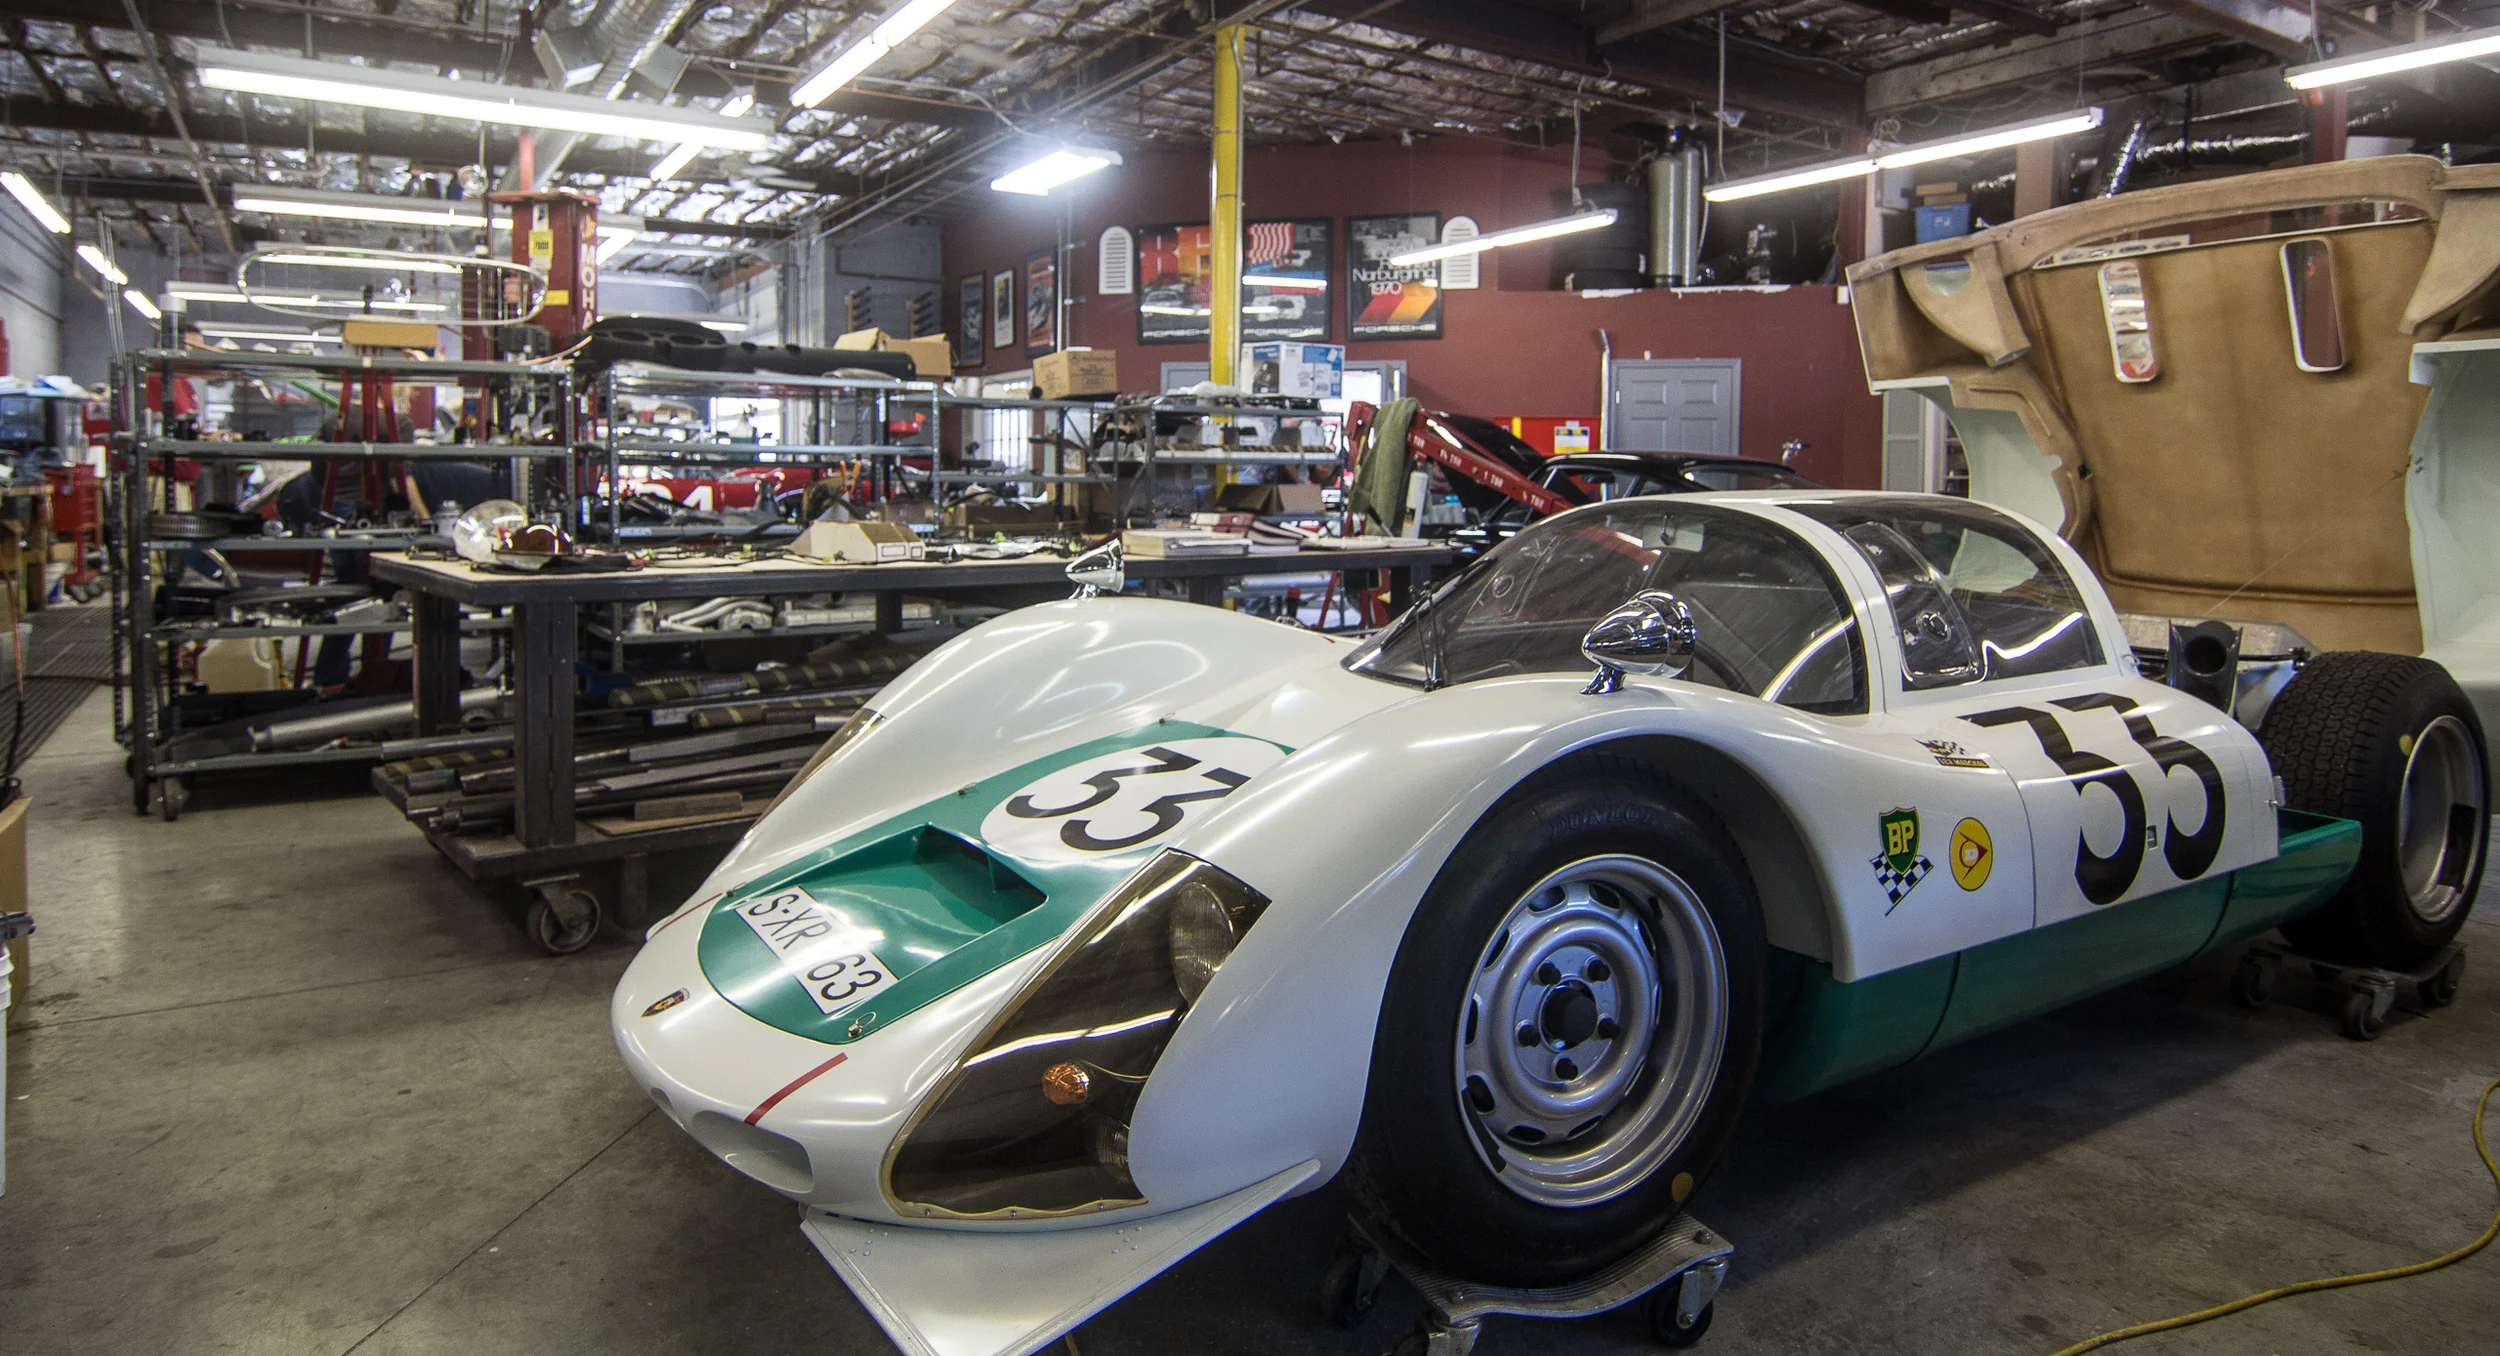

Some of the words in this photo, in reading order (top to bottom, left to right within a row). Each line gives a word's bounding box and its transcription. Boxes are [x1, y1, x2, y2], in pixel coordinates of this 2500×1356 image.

[581, 243, 597, 332] MOHA
[1368, 280, 1403, 296] 1970
[1005, 746, 1252, 852] 33
[1955, 692, 2226, 906] 33
[1886, 819, 1915, 857] BP
[806, 954, 882, 1001] 63
